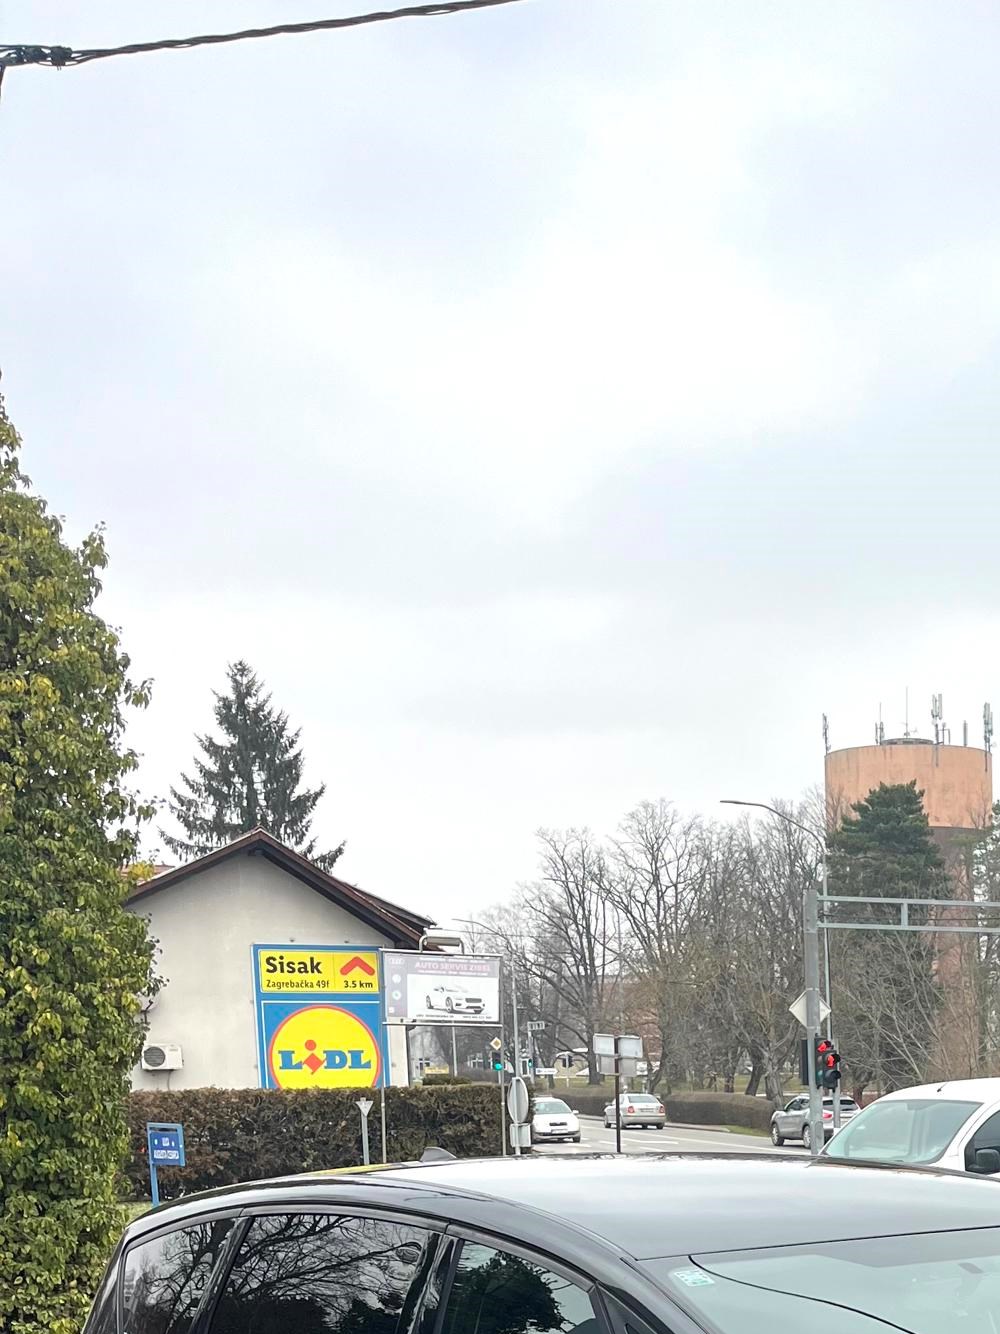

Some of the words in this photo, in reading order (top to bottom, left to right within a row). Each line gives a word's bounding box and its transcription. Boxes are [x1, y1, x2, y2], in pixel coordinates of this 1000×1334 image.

[265, 955, 322, 974] Sisak
[415, 961, 439, 970] AUTO
[266, 979, 314, 990] Zagrebačka
[343, 980, 357, 989] 3.5
[359, 980, 373, 989] km
